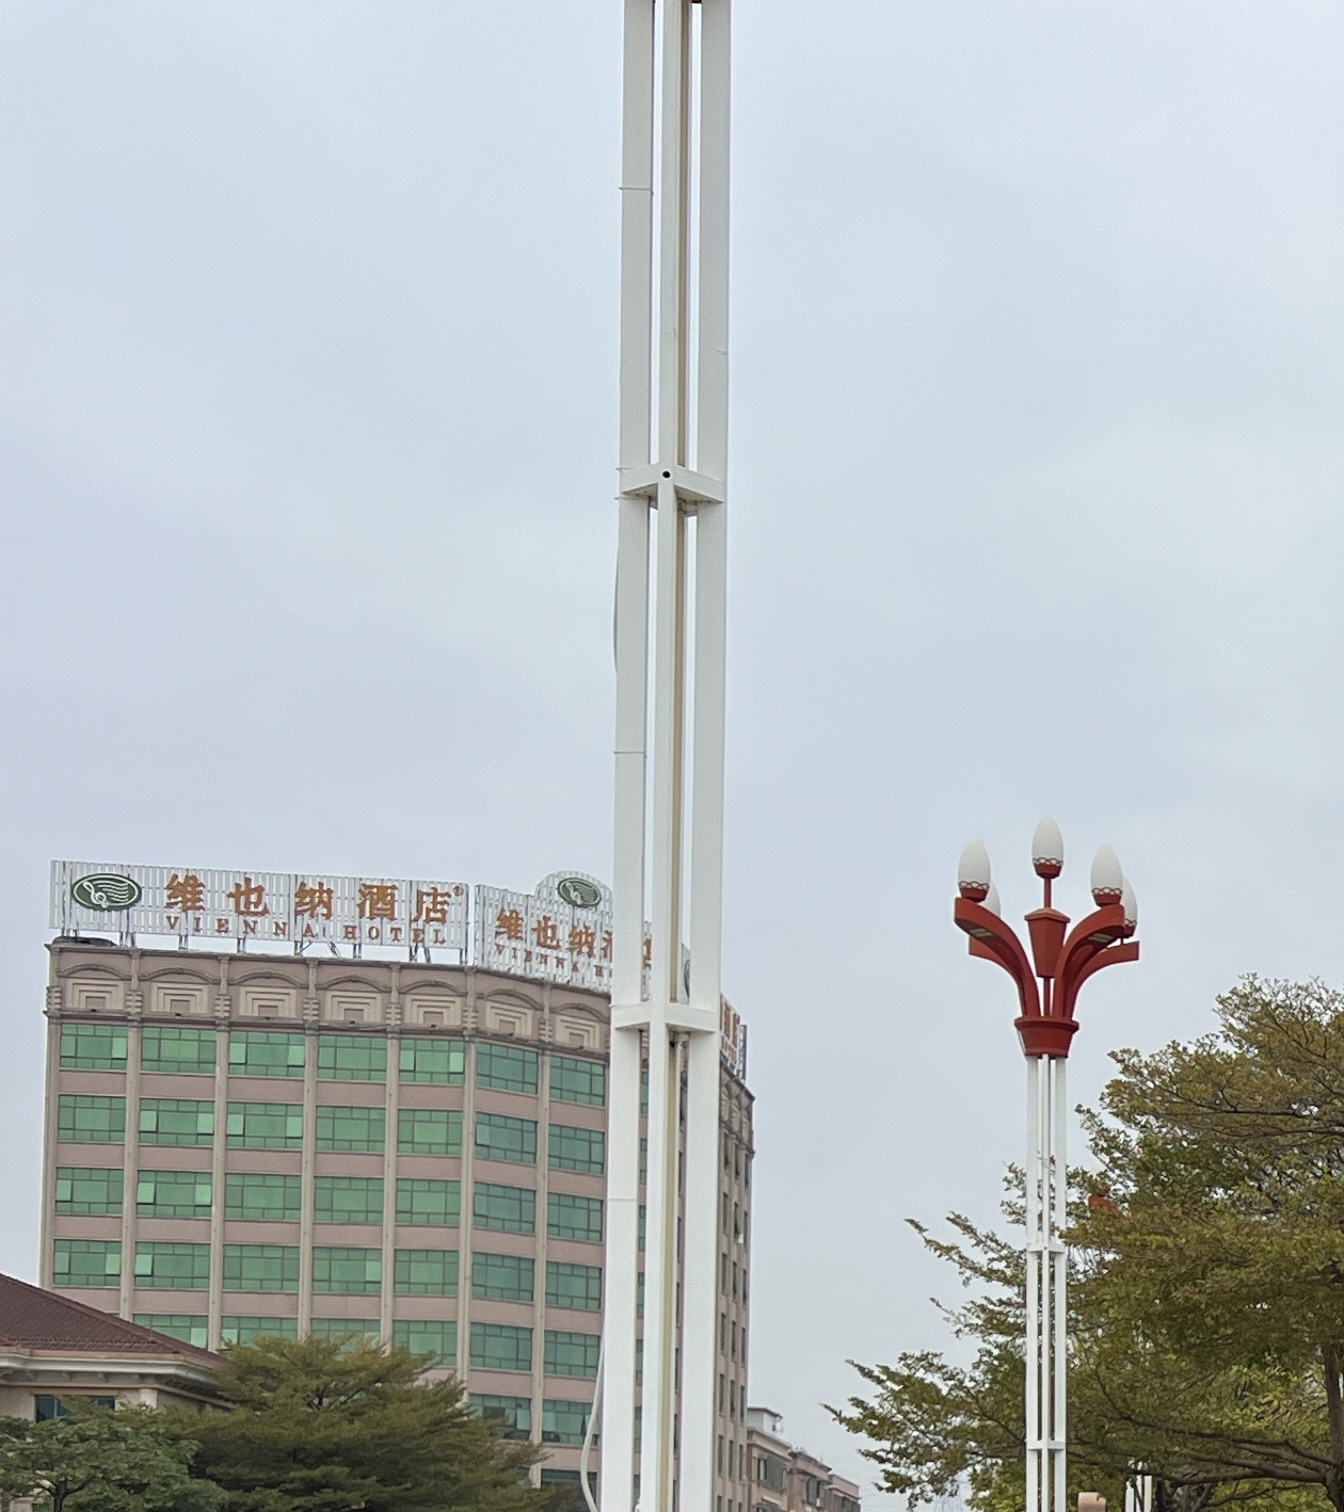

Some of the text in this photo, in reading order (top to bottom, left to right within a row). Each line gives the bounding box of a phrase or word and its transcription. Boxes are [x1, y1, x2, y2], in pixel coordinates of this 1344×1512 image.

[164, 872, 451, 925] 维也纳酒店
[165, 915, 447, 945] VIENNA HOTEL
